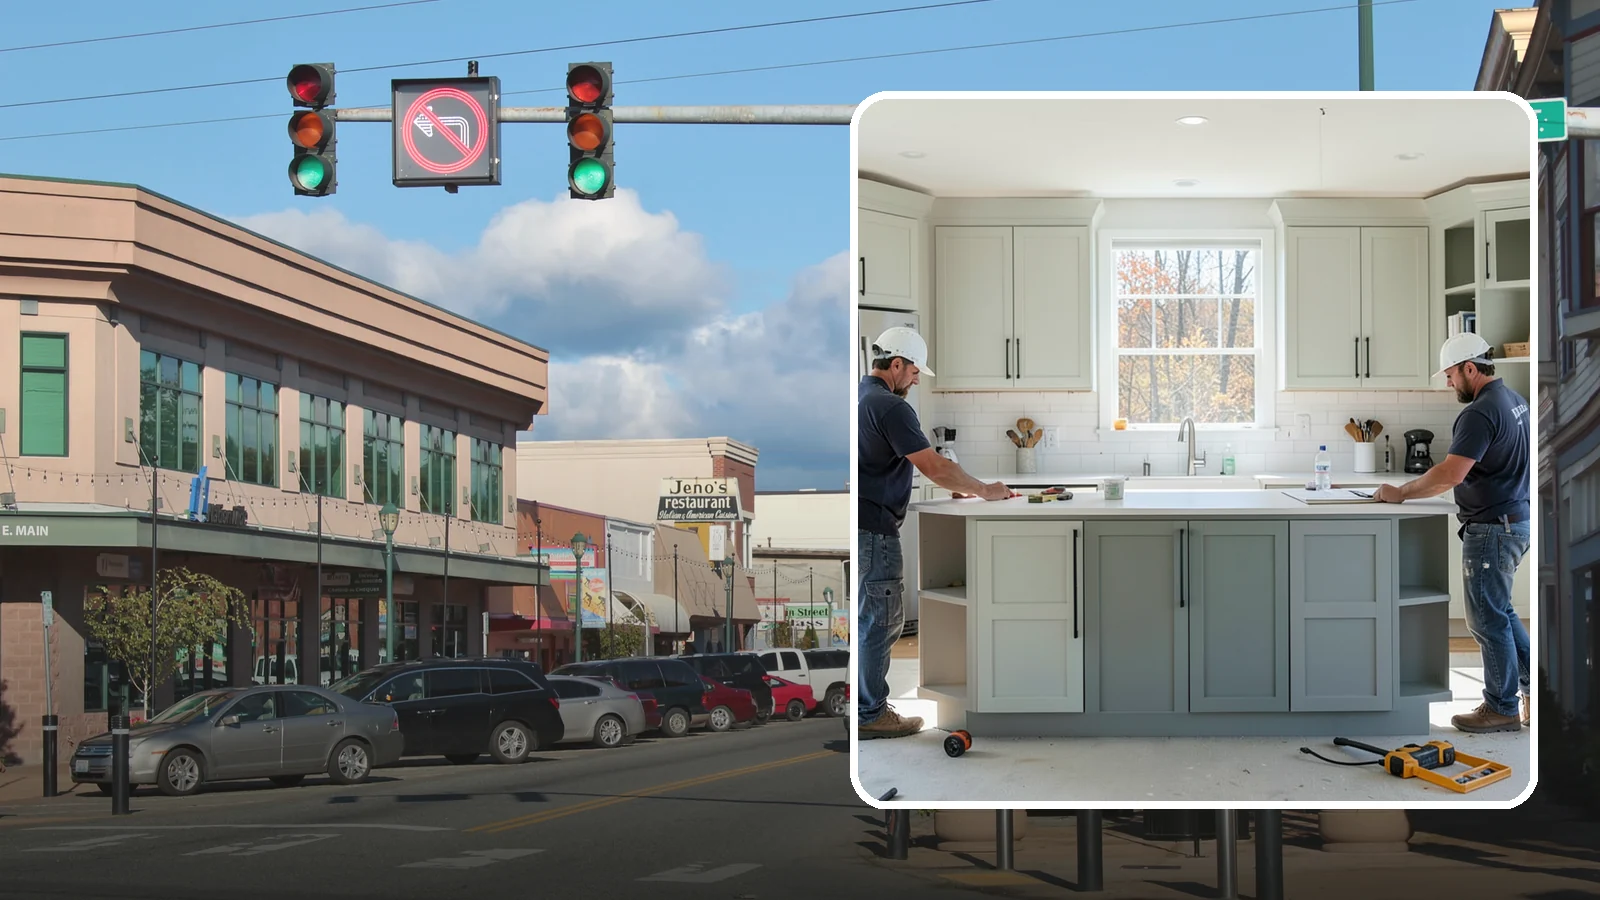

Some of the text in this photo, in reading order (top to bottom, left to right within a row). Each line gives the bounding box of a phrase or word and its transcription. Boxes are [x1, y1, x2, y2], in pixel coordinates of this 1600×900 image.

[670, 480, 727, 494] Jeno's
[665, 496, 731, 509] restaurant
[659, 510, 681, 519] Italian
[686, 510, 714, 519] American
[715, 510, 737, 519] Cuisine
[2, 525, 49, 536] E. MAIN
[797, 607, 828, 617] Street
